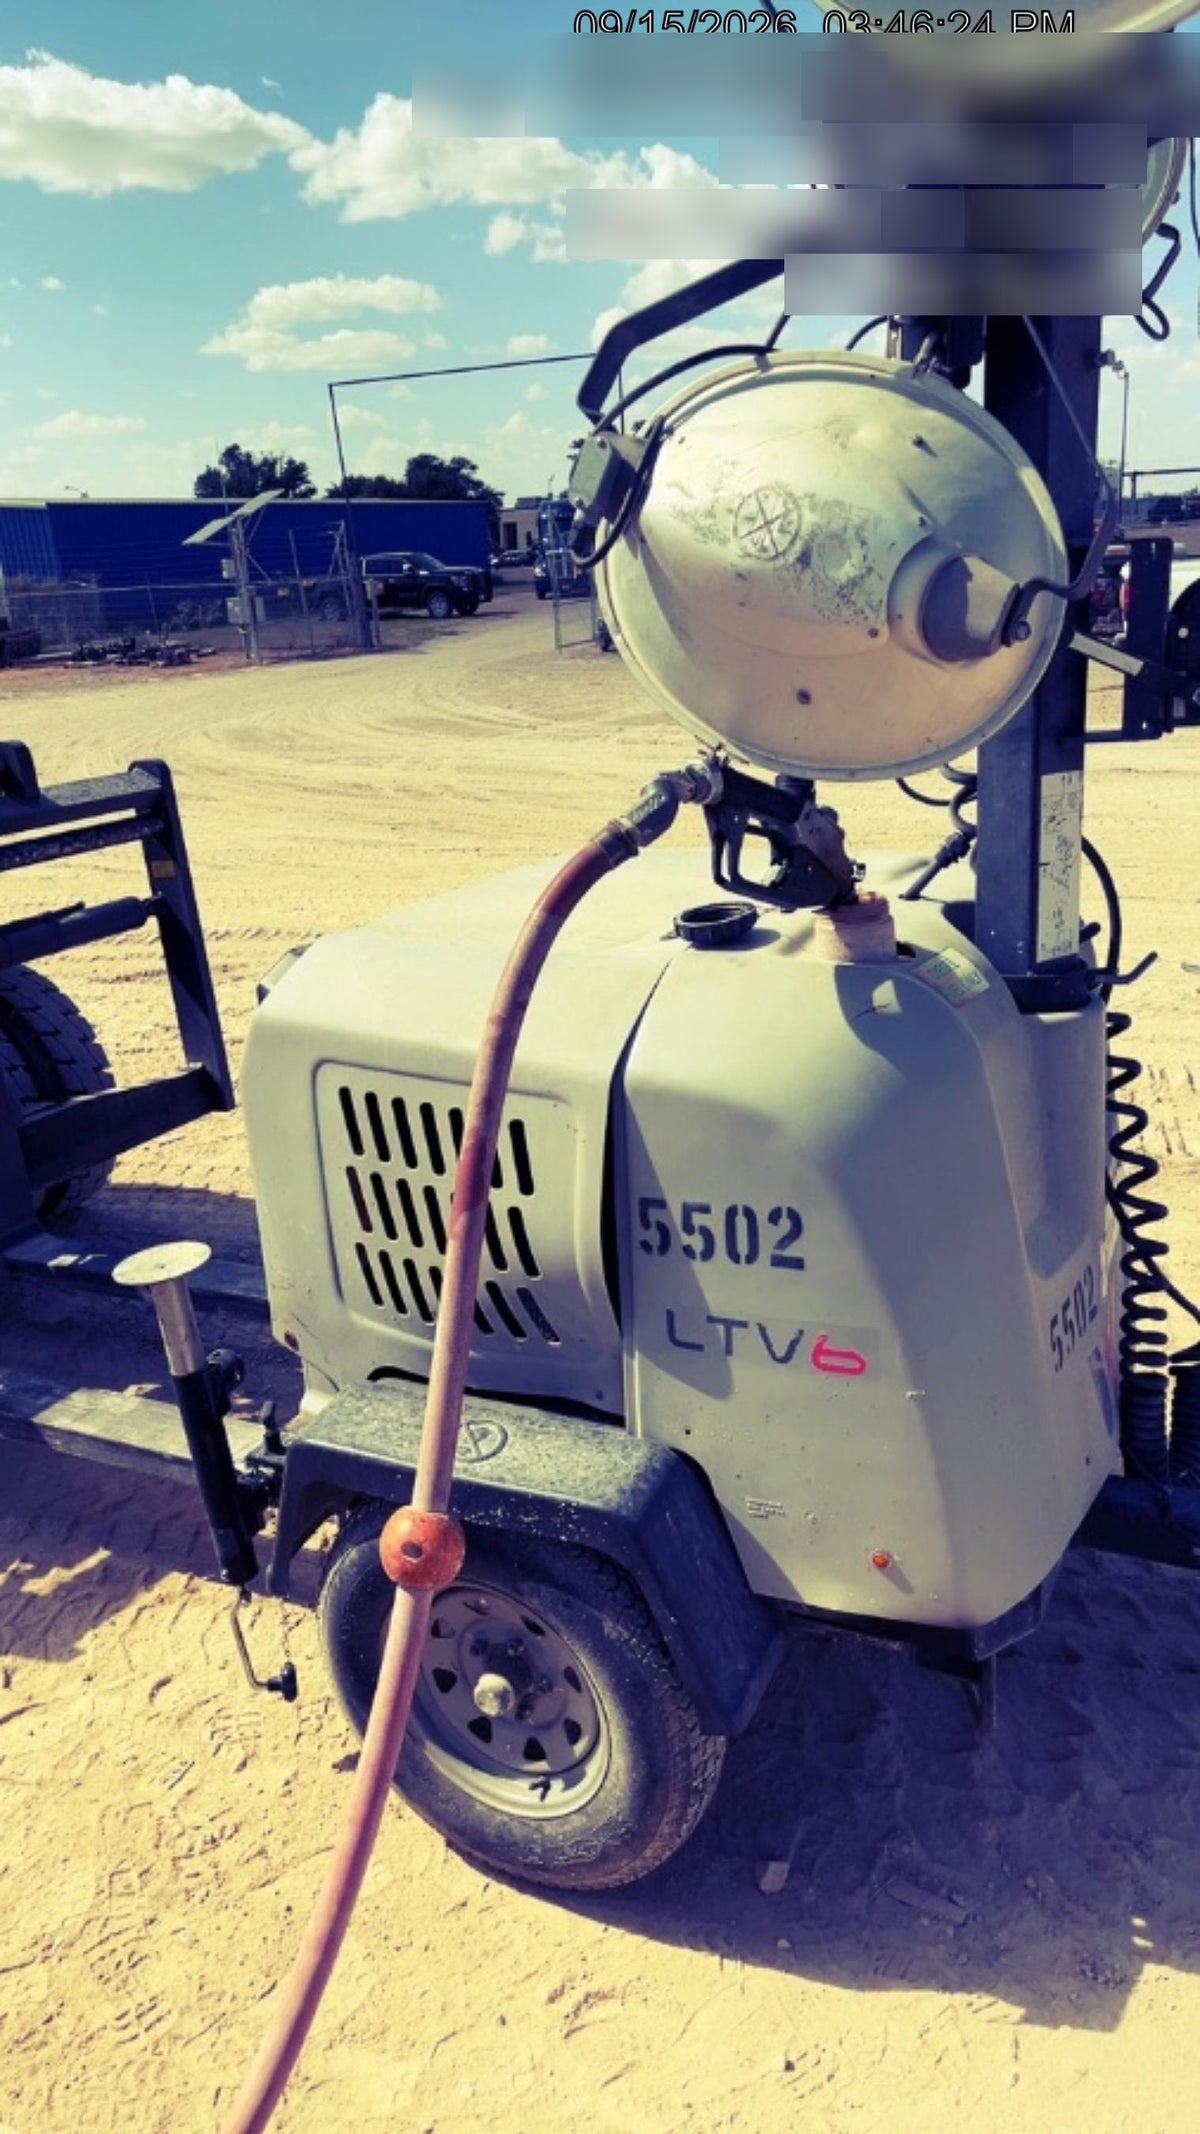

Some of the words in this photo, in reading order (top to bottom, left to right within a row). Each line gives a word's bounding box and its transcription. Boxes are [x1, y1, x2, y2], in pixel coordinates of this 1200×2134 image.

[638, 1197, 805, 1271] 5502
[666, 1308, 867, 1376] LTV6
[1050, 1264, 1098, 1374] 5502
